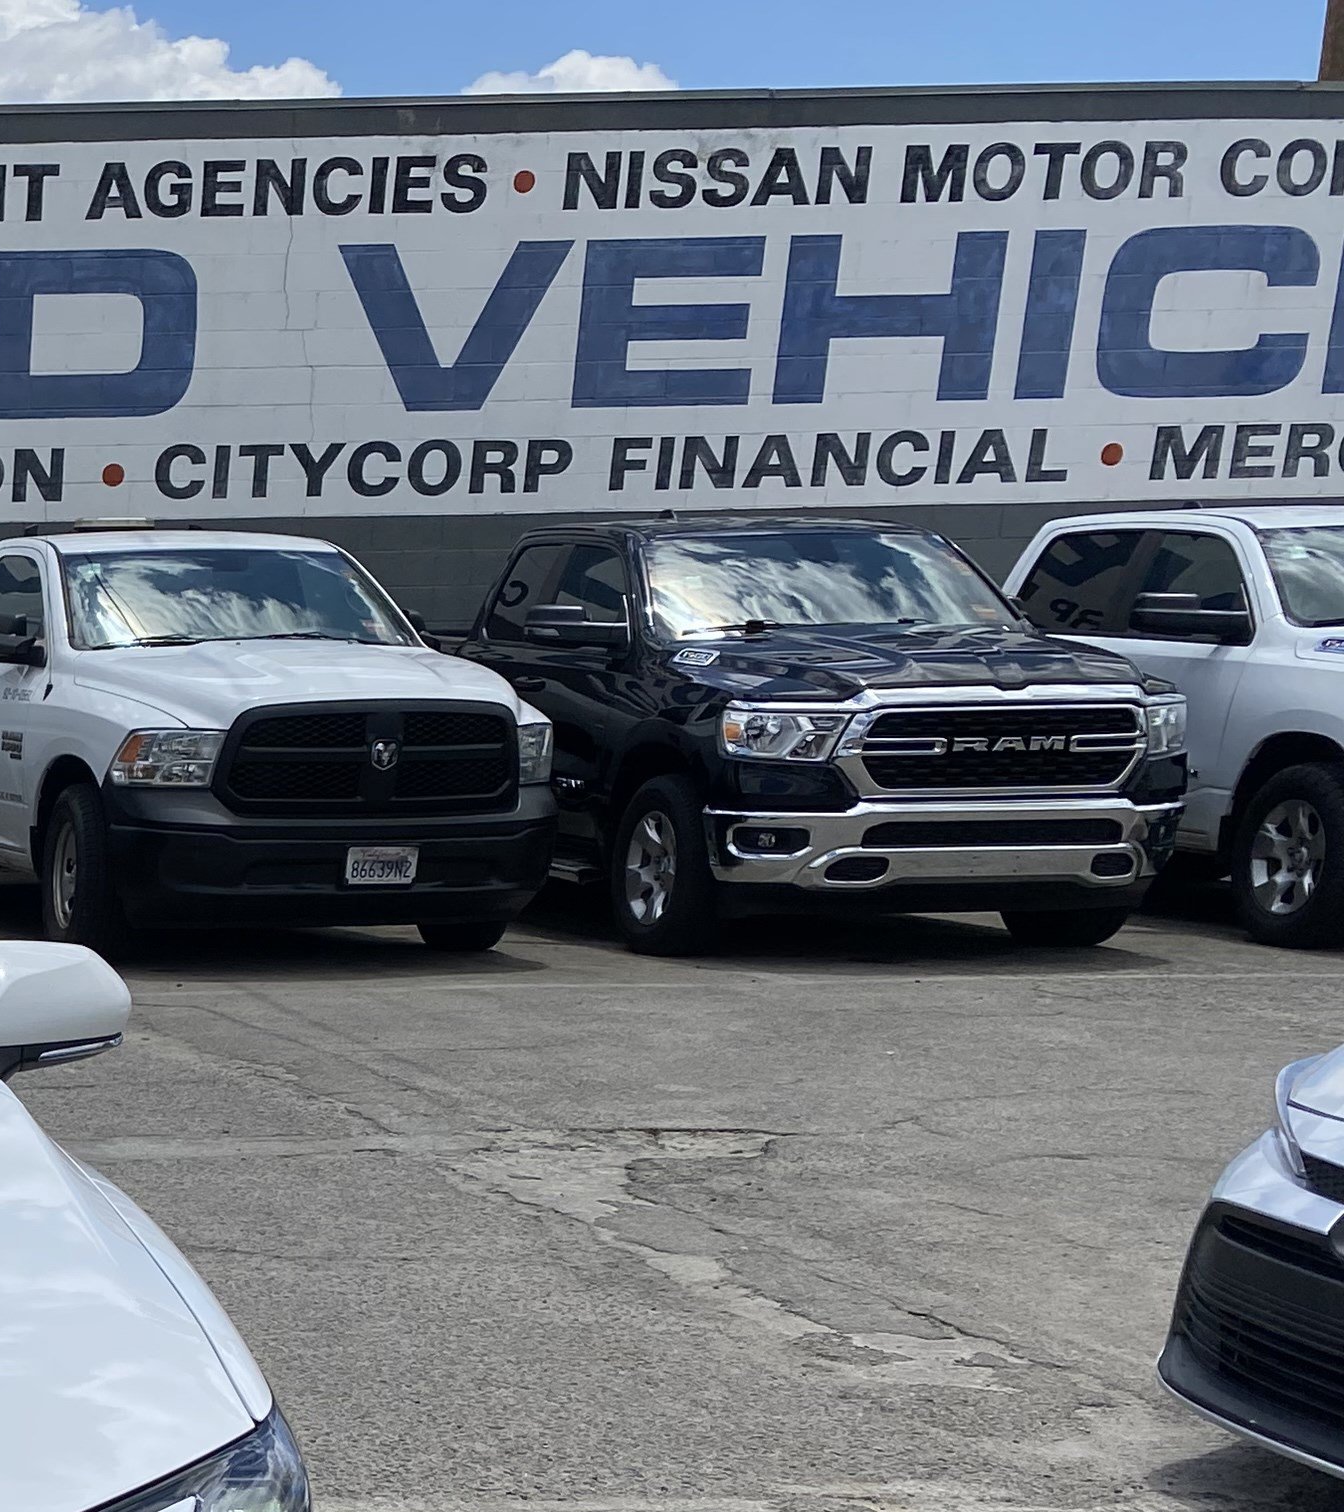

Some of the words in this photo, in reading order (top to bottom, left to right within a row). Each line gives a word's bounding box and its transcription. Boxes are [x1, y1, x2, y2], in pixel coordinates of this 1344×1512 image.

[84, 153, 488, 221] AGENCIES
[561, 145, 873, 212] NISSAN
[899, 140, 1188, 204] MOTOR
[338, 224, 1344, 412] VEHIC
[154, 438, 573, 500] CITYCORP
[608, 428, 1069, 492] FINANCIAL
[1148, 422, 1344, 481] MER
[953, 735, 1066, 753] RAM
